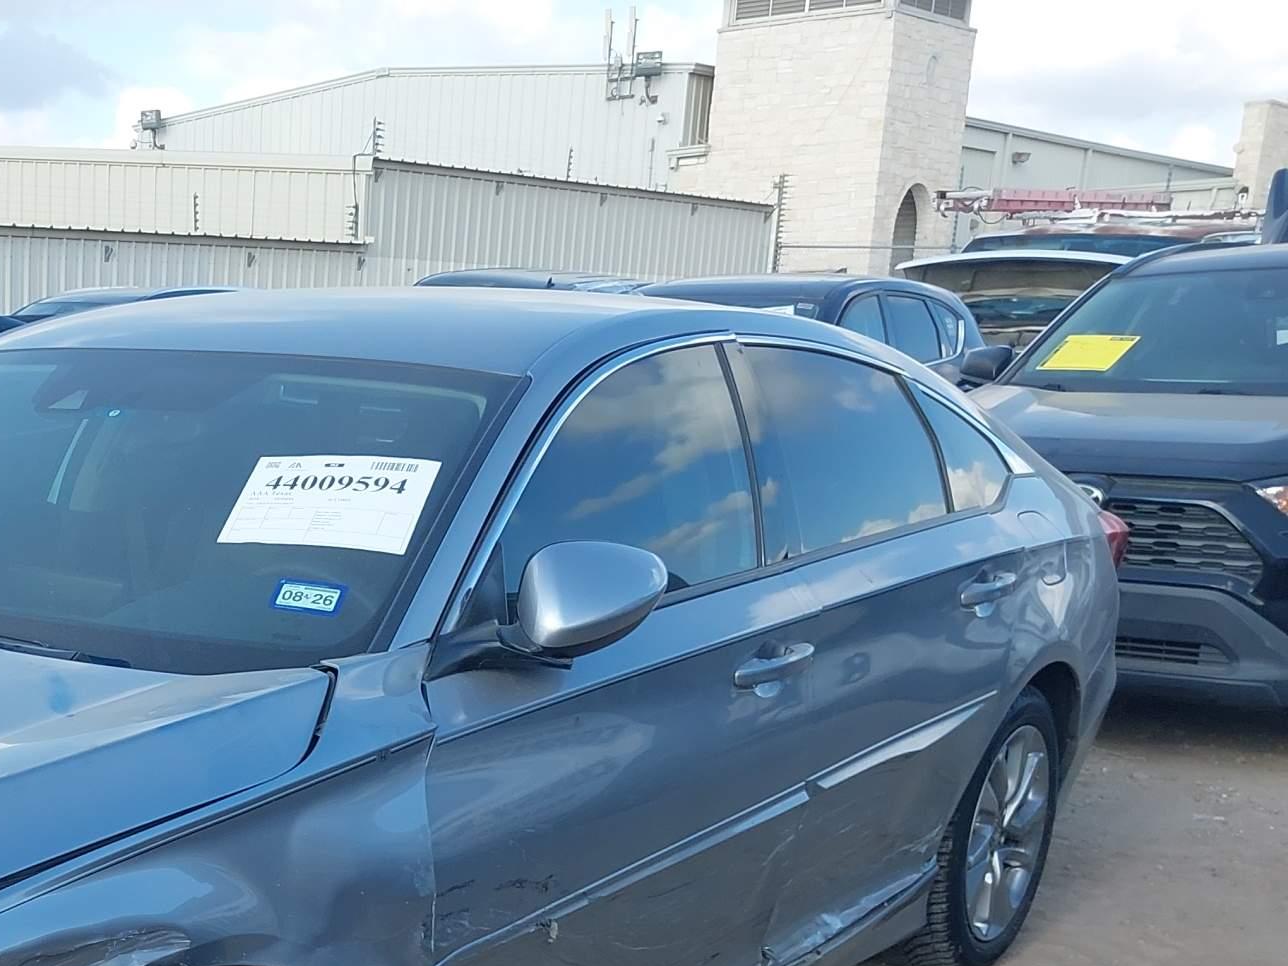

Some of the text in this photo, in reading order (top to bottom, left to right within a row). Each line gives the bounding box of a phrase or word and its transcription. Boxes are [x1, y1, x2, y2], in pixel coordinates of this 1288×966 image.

[265, 475, 408, 494] 44009594
[281, 590, 334, 606] 08 26
